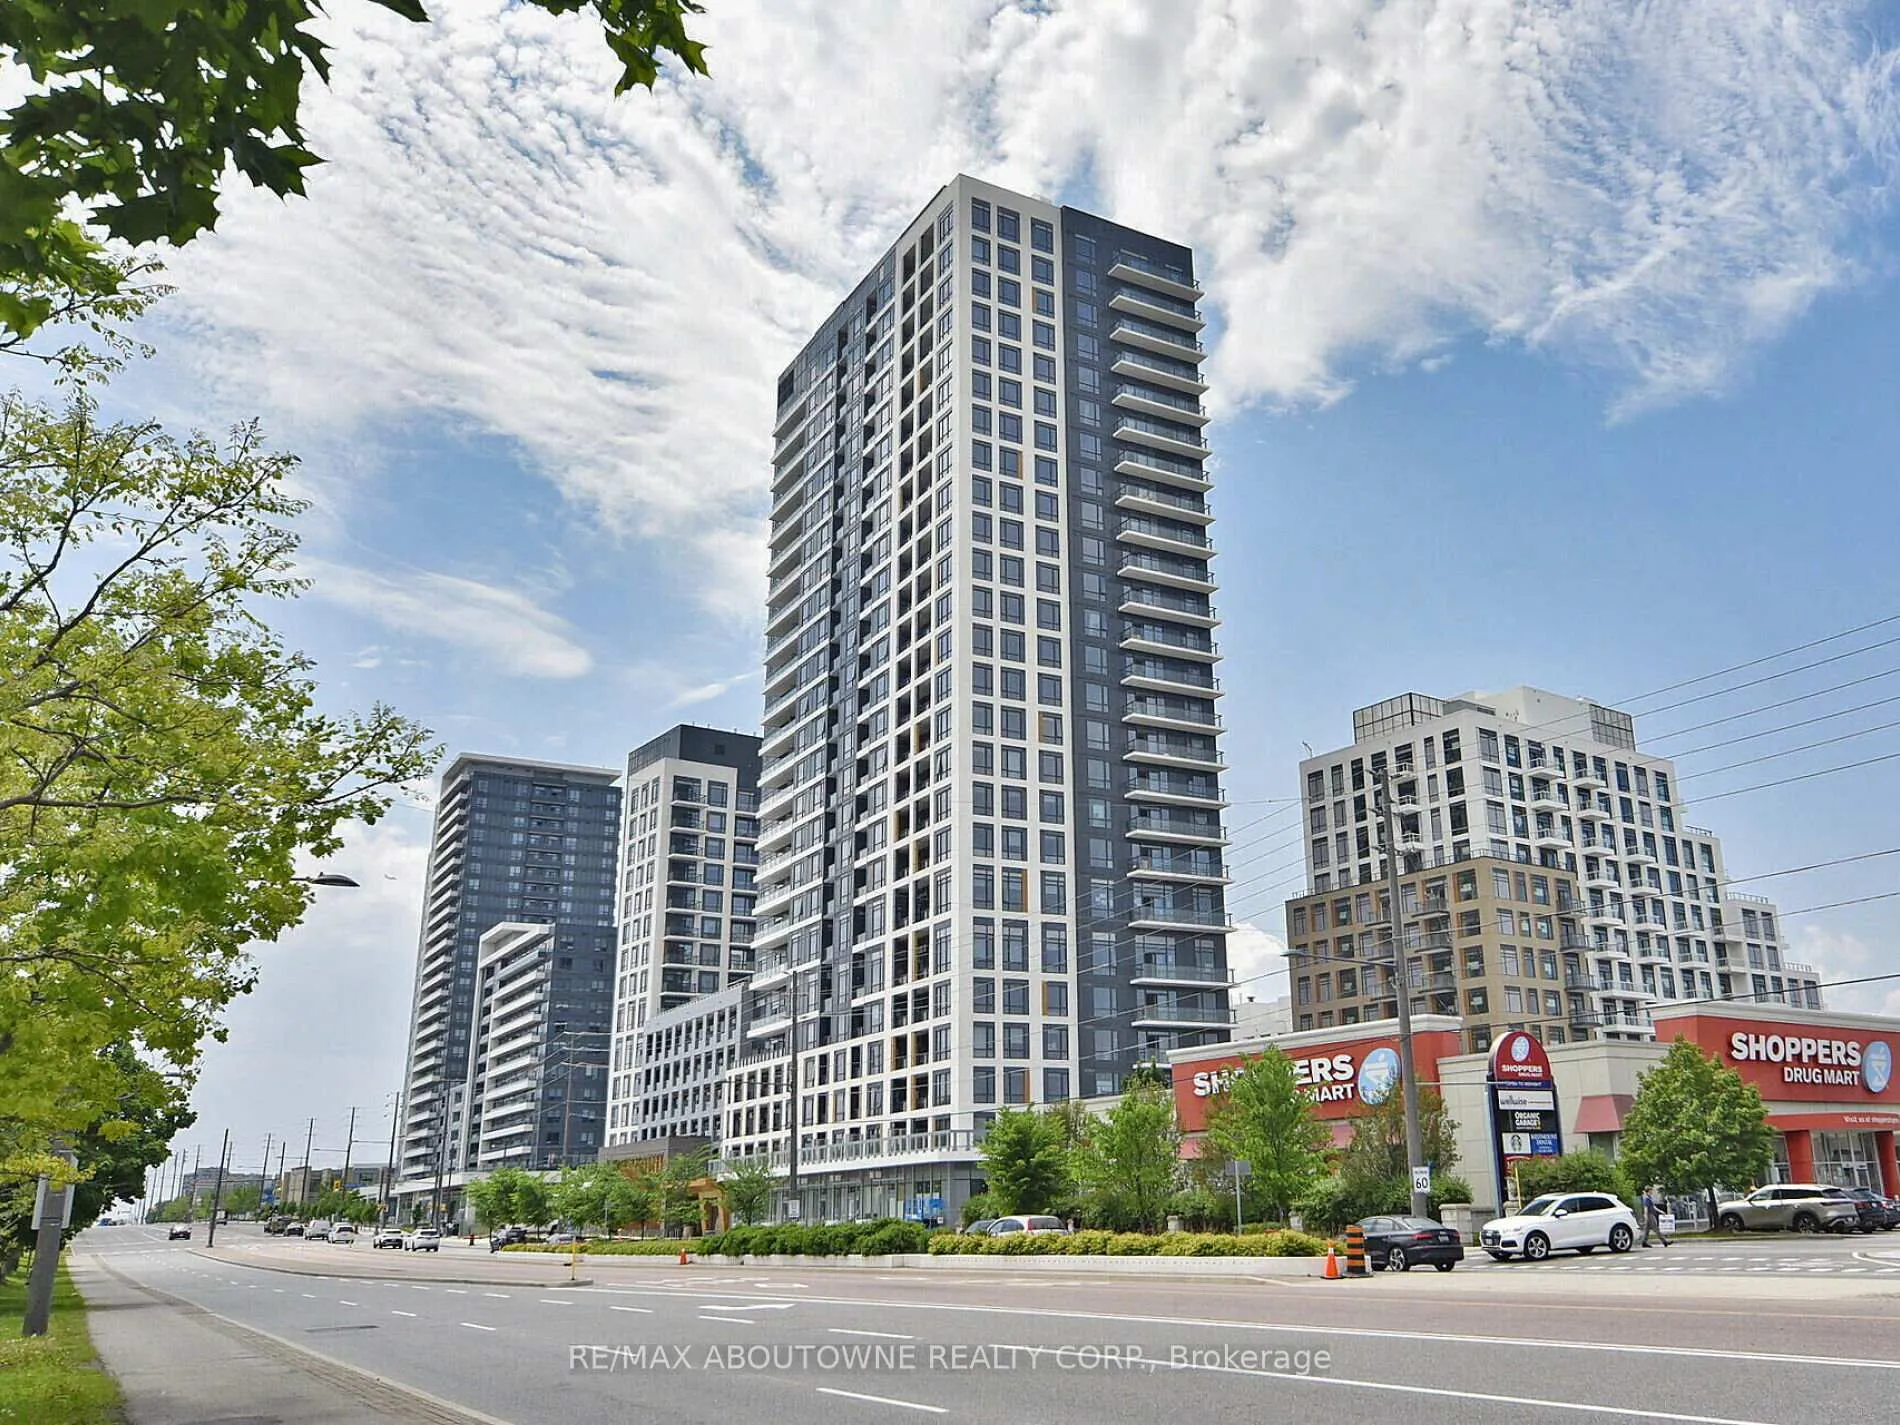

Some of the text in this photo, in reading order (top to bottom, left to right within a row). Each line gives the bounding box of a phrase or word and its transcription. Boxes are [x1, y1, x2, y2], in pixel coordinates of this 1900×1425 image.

[1731, 1032, 1862, 1067] SHOPPERS
[1501, 1064, 1543, 1073] SHOPPERS
[1783, 1067, 1860, 1086] DRUG MART
[1514, 1111, 1541, 1120] ORGANIC
[1415, 1177, 1428, 1189] 60
